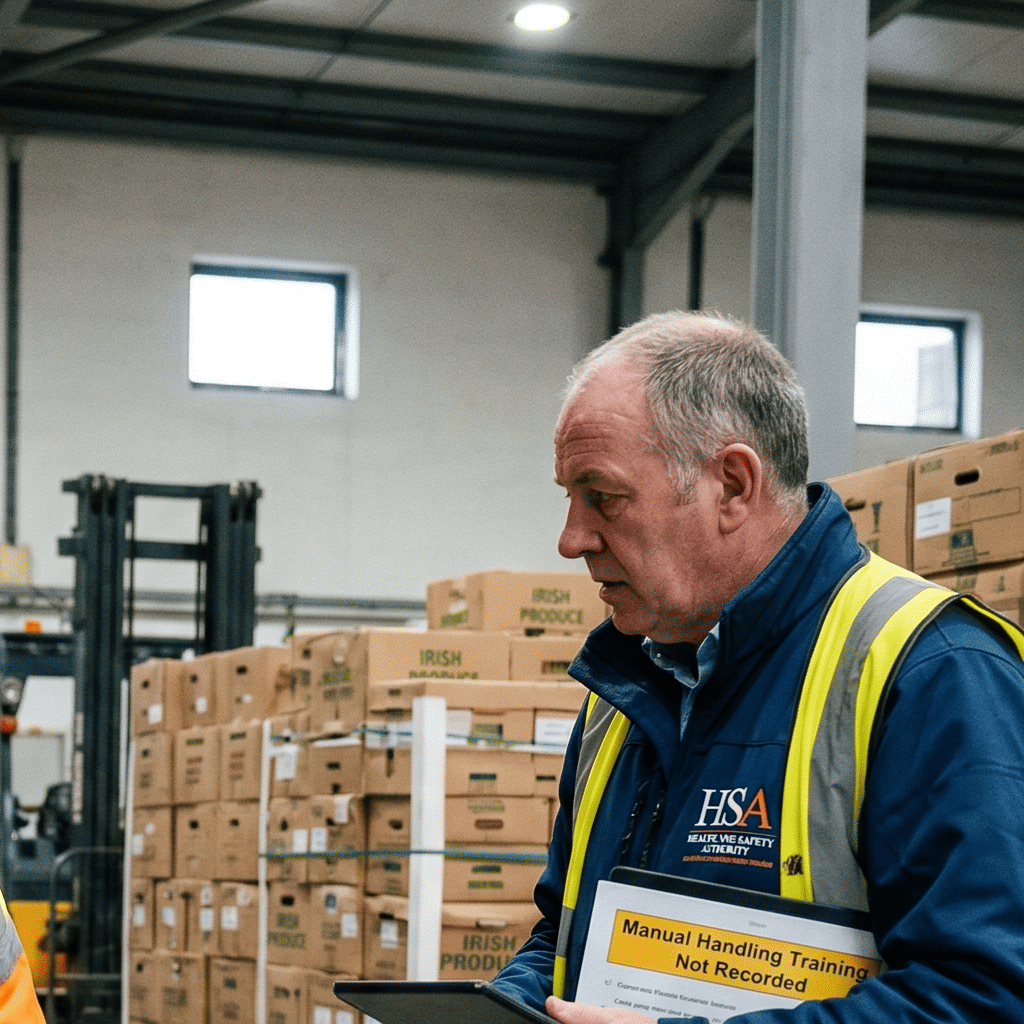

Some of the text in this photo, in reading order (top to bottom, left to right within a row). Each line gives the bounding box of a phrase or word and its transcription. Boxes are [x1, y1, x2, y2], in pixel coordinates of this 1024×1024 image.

[419, 649, 462, 667] IRISH
[694, 786, 773, 830] HSA
[462, 934, 517, 951] IRISH
[622, 918, 870, 983] Manual Handling Training
[675, 953, 809, 994] Not Recorded
